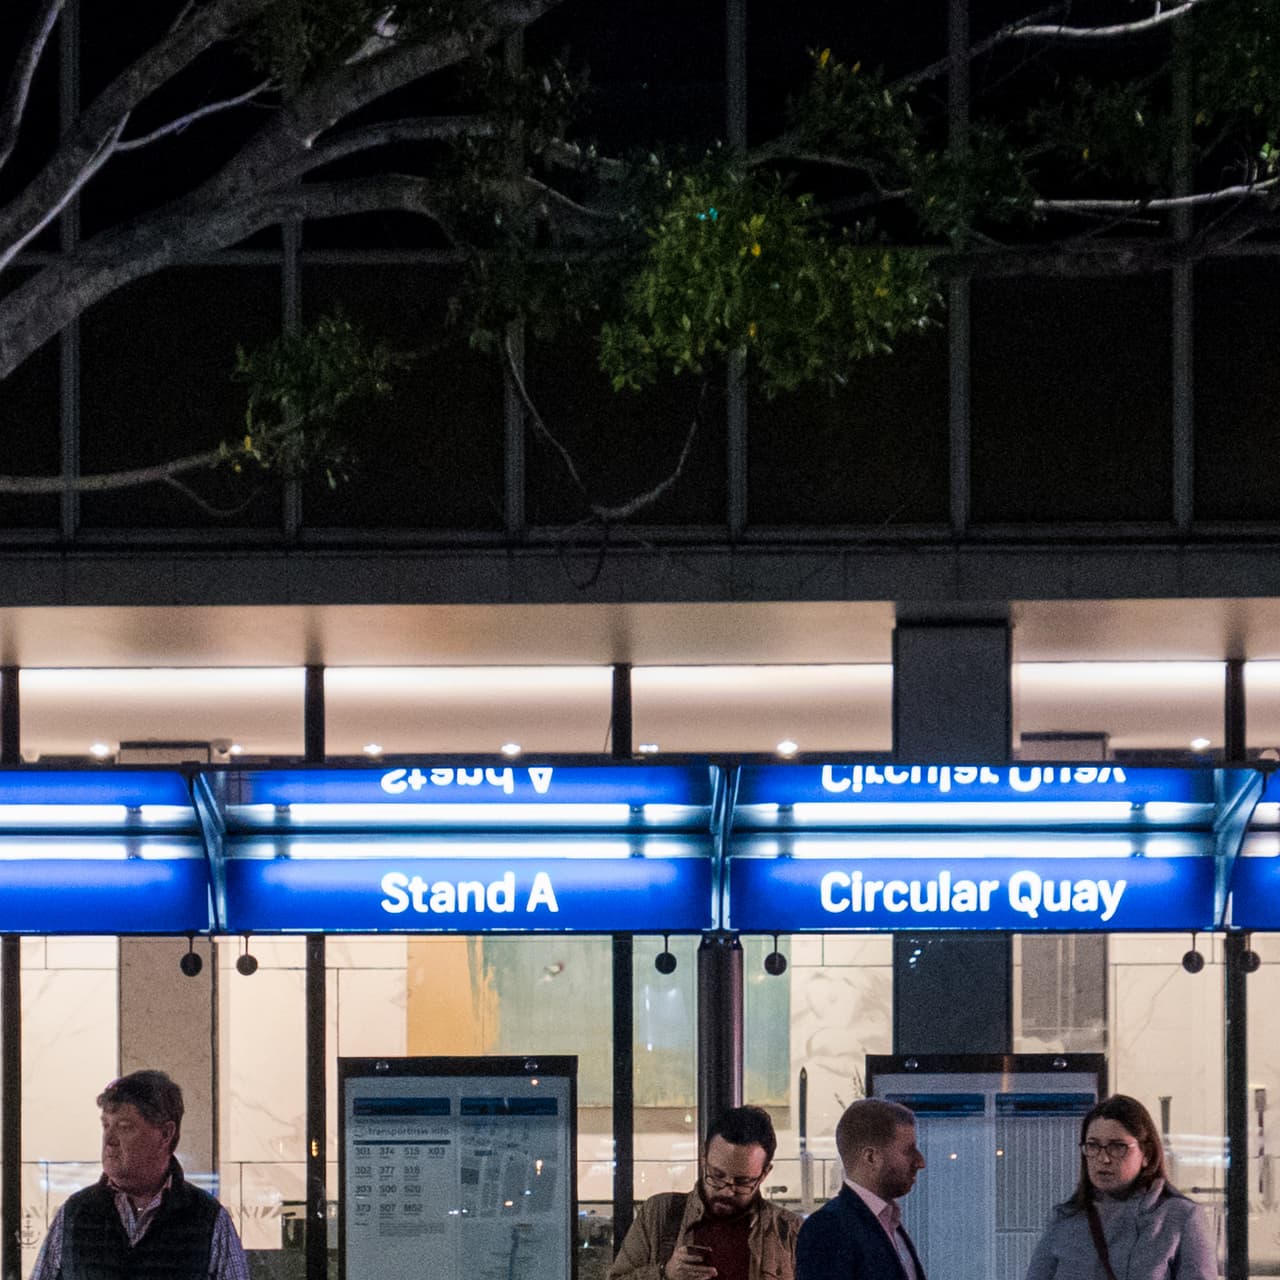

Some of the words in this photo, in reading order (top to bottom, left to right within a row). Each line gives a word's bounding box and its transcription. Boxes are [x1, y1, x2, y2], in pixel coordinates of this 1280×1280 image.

[380, 869, 517, 914] Stand
[526, 870, 559, 913] A
[820, 869, 1000, 914] Circular
[1008, 869, 1127, 922] Quay
